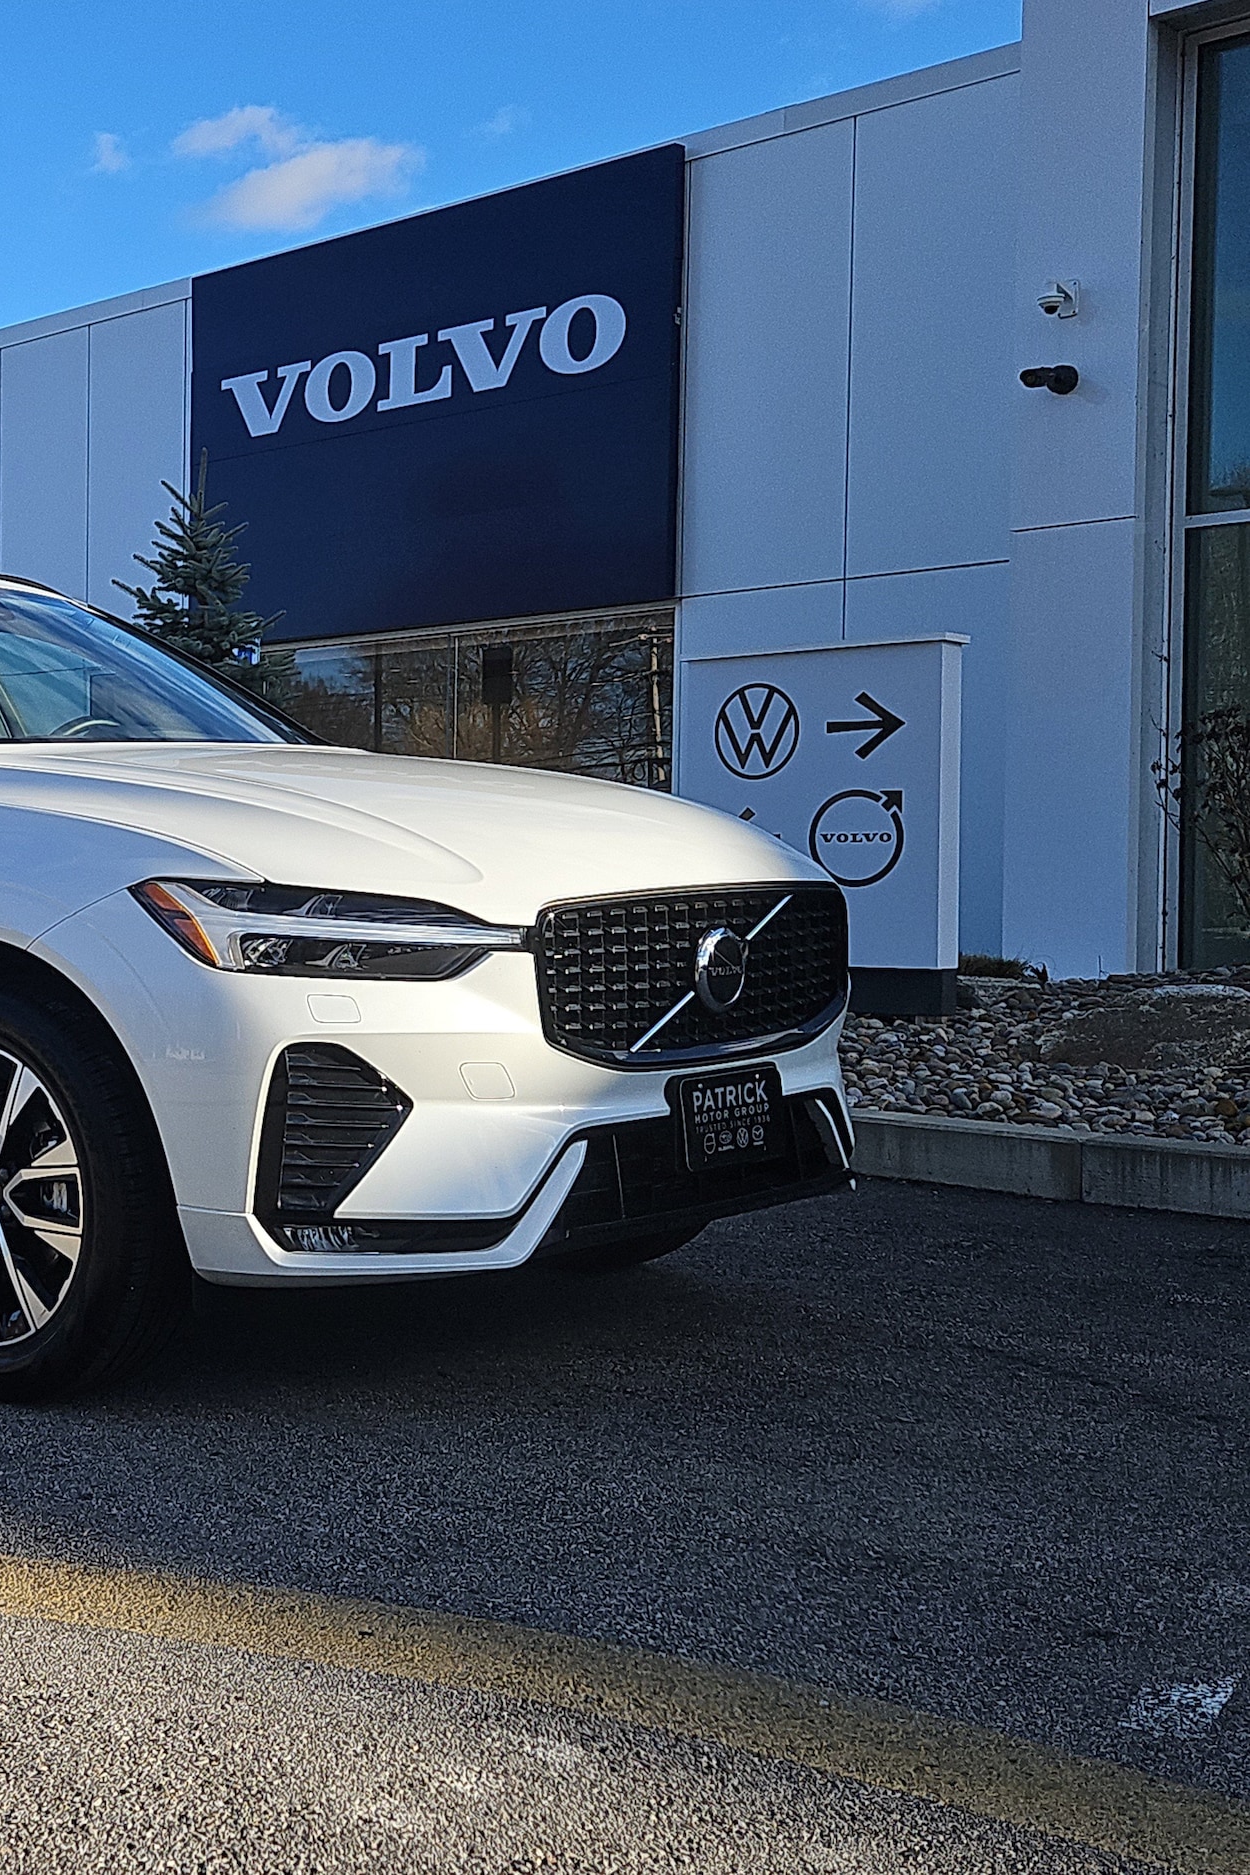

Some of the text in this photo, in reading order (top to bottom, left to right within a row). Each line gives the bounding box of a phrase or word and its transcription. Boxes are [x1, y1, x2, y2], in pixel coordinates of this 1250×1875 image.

[220, 294, 626, 437] VOLVO
[820, 832, 892, 843] VOLVO
[692, 1080, 768, 1113] PATRICK
[695, 1103, 769, 1124] MOTOR GROUP
[730, 1117, 750, 1128] SINCE
